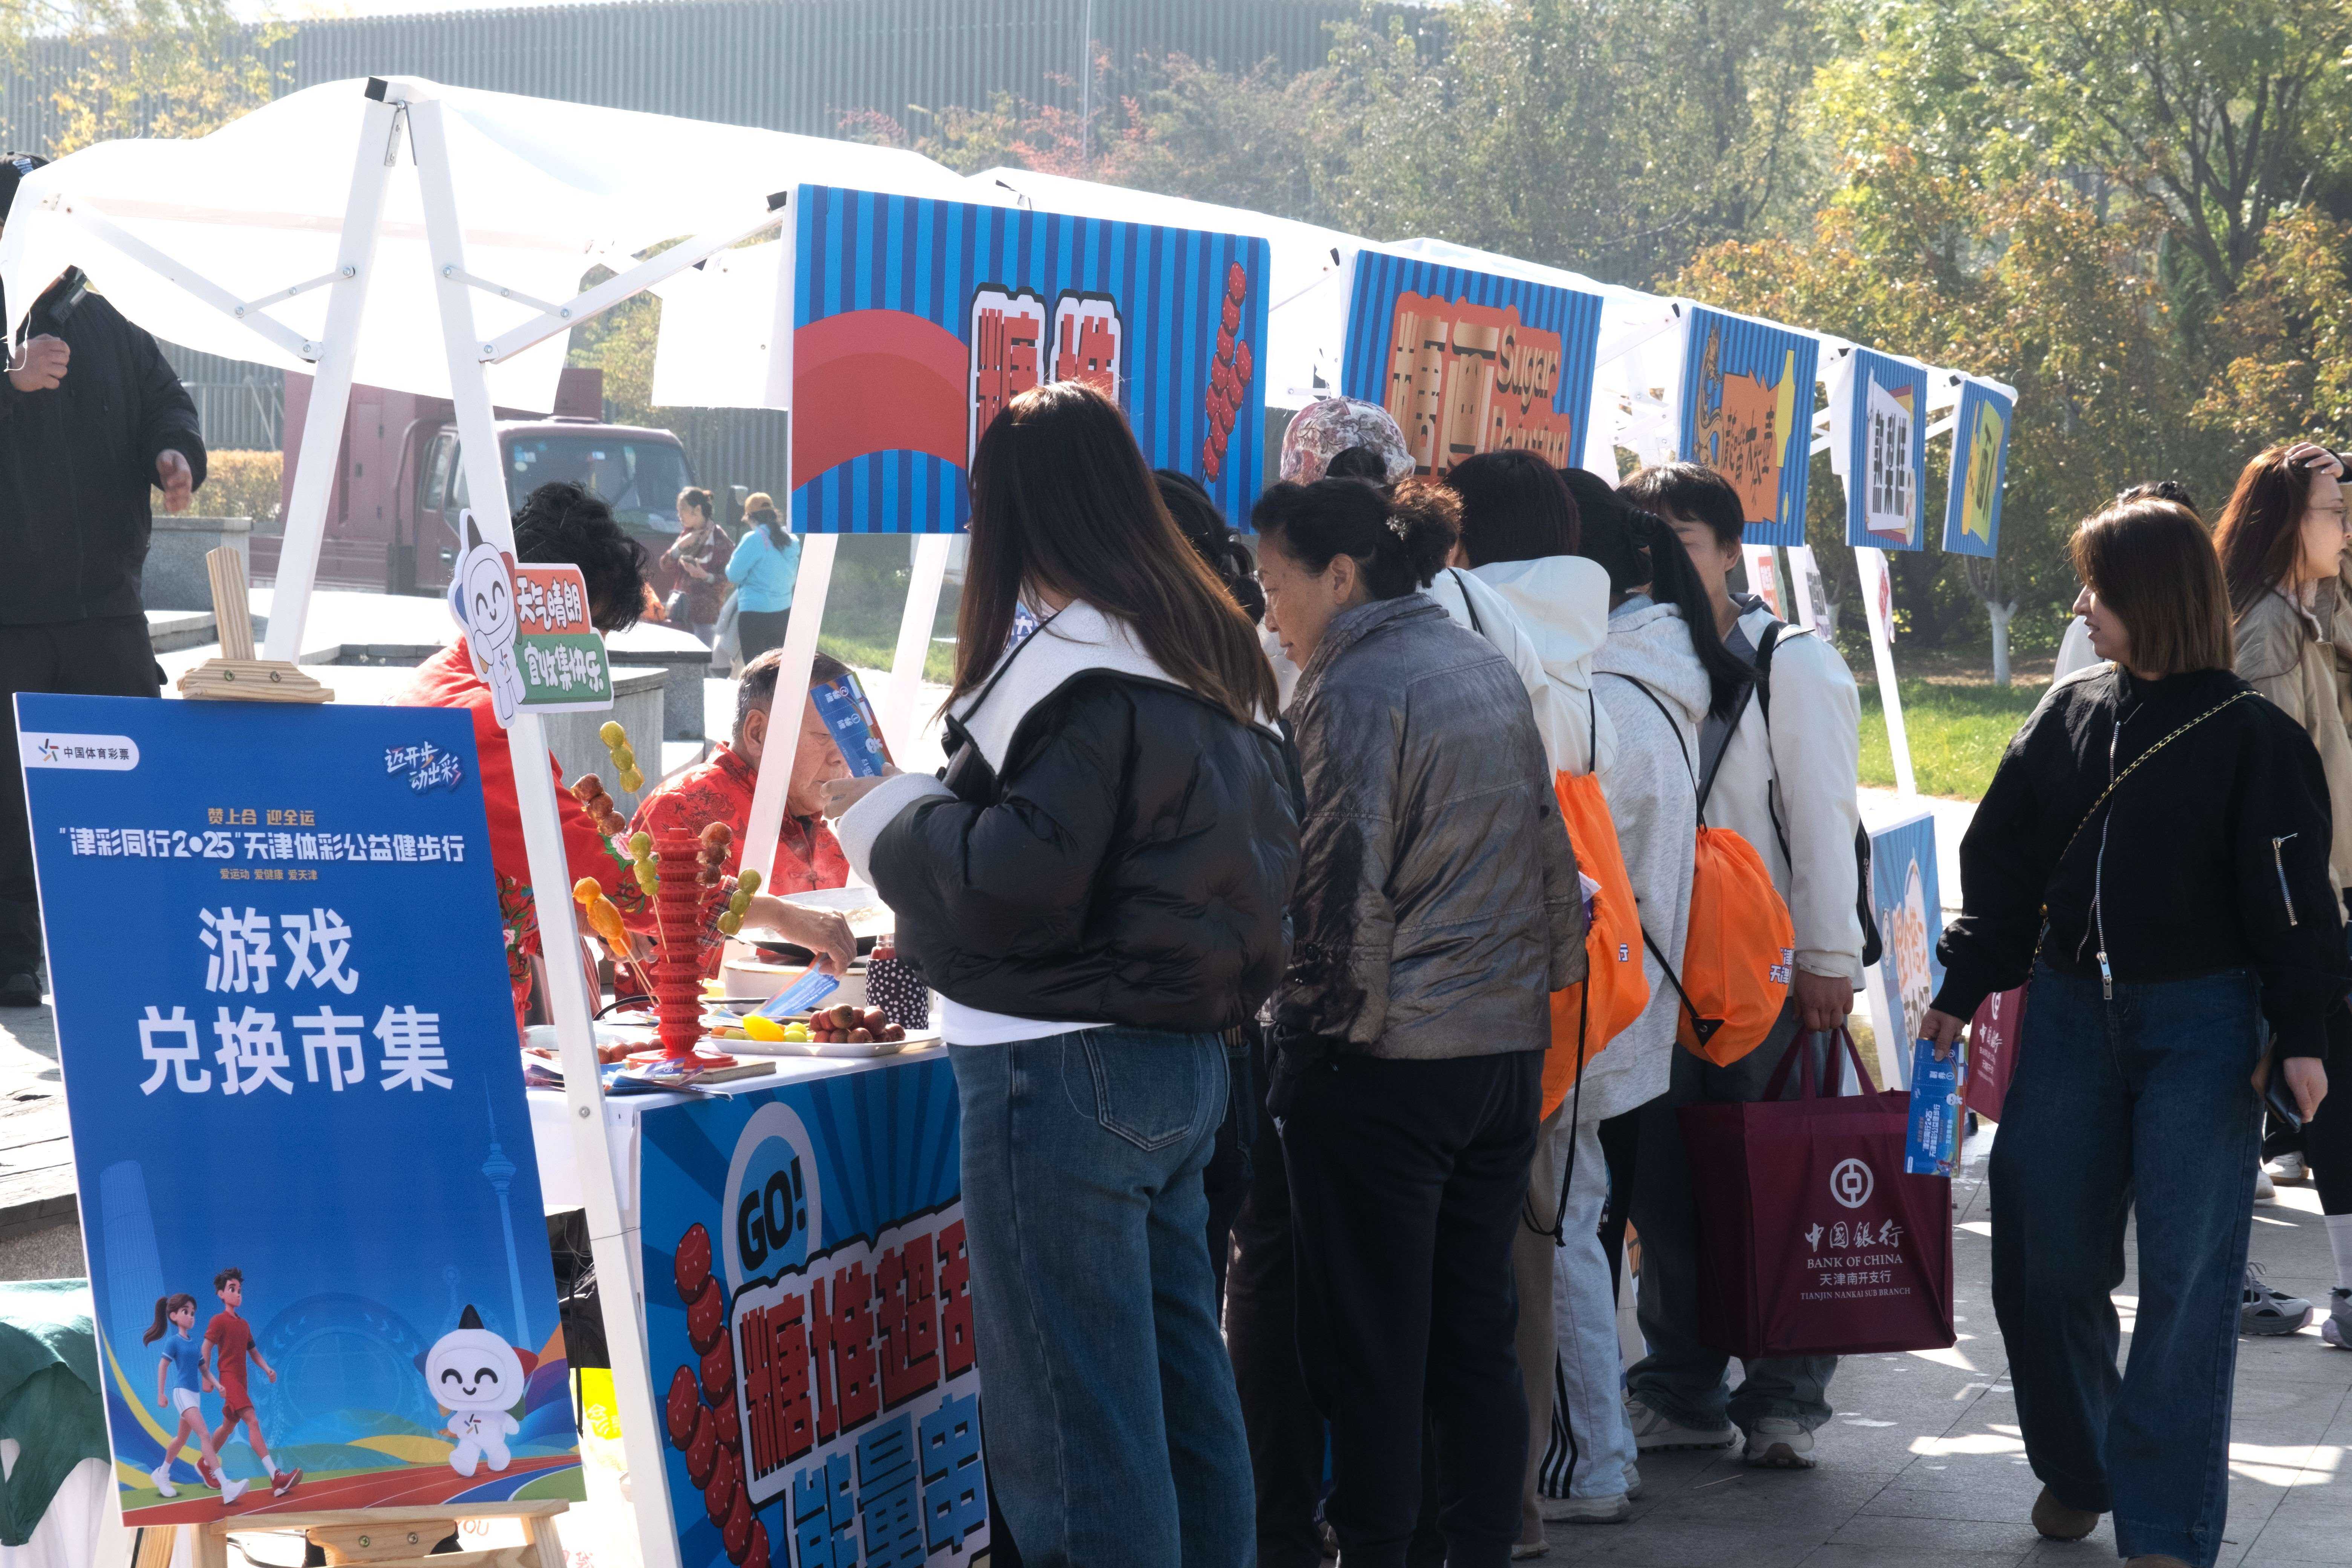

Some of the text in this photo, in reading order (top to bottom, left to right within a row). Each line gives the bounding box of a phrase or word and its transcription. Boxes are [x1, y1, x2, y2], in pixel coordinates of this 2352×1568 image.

[1496, 323, 1558, 408] Sugar
[516, 576, 582, 631] 天气晴朗
[524, 642, 603, 693] 宜收集快乐
[63, 746, 129, 761] 中国体育彩票
[384, 741, 439, 773] 迈开步
[409, 753, 461, 790] 动出彩
[208, 808, 315, 827] 赞上合 迎全运
[220, 868, 318, 882] 爱运动 爱健康 爱天津
[198, 907, 359, 994] 游戏
[138, 1005, 454, 1096] 兑换市集
[737, 1155, 806, 1272] GO!
[1807, 1254, 1903, 1269] BANK OF CHINA
[1820, 1270, 1891, 1286] 天津南开支行
[1801, 1292, 1832, 1300] TIANJIN
[1834, 1290, 1864, 1299] NANKAI
[1879, 1287, 1911, 1296] BRANCH
